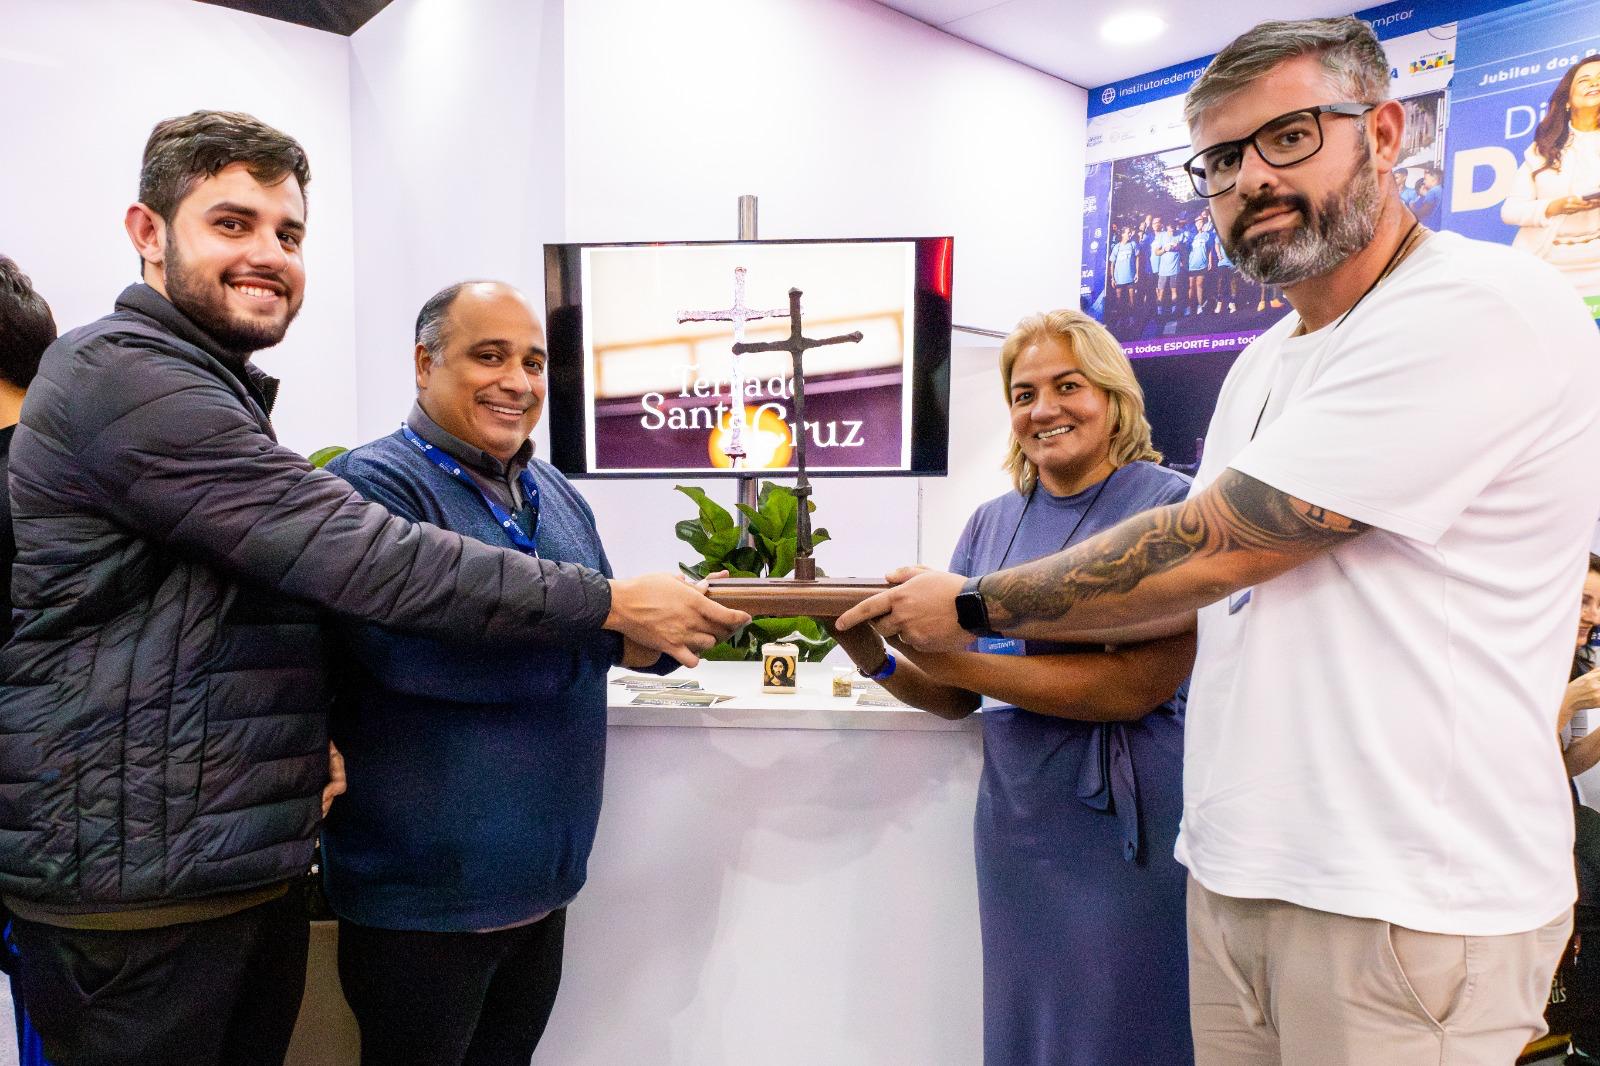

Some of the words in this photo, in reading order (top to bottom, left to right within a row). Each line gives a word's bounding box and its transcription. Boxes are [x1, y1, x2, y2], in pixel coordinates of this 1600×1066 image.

[1369, 9, 1414, 28] mptor
[1479, 64, 1541, 86] Jubileu
[1546, 54, 1579, 71] dos
[1135, 344, 1162, 354] todos
[1164, 339, 1210, 351] ESPORTE
[1212, 337, 1235, 348] para
[753, 402, 865, 448] Cruz
